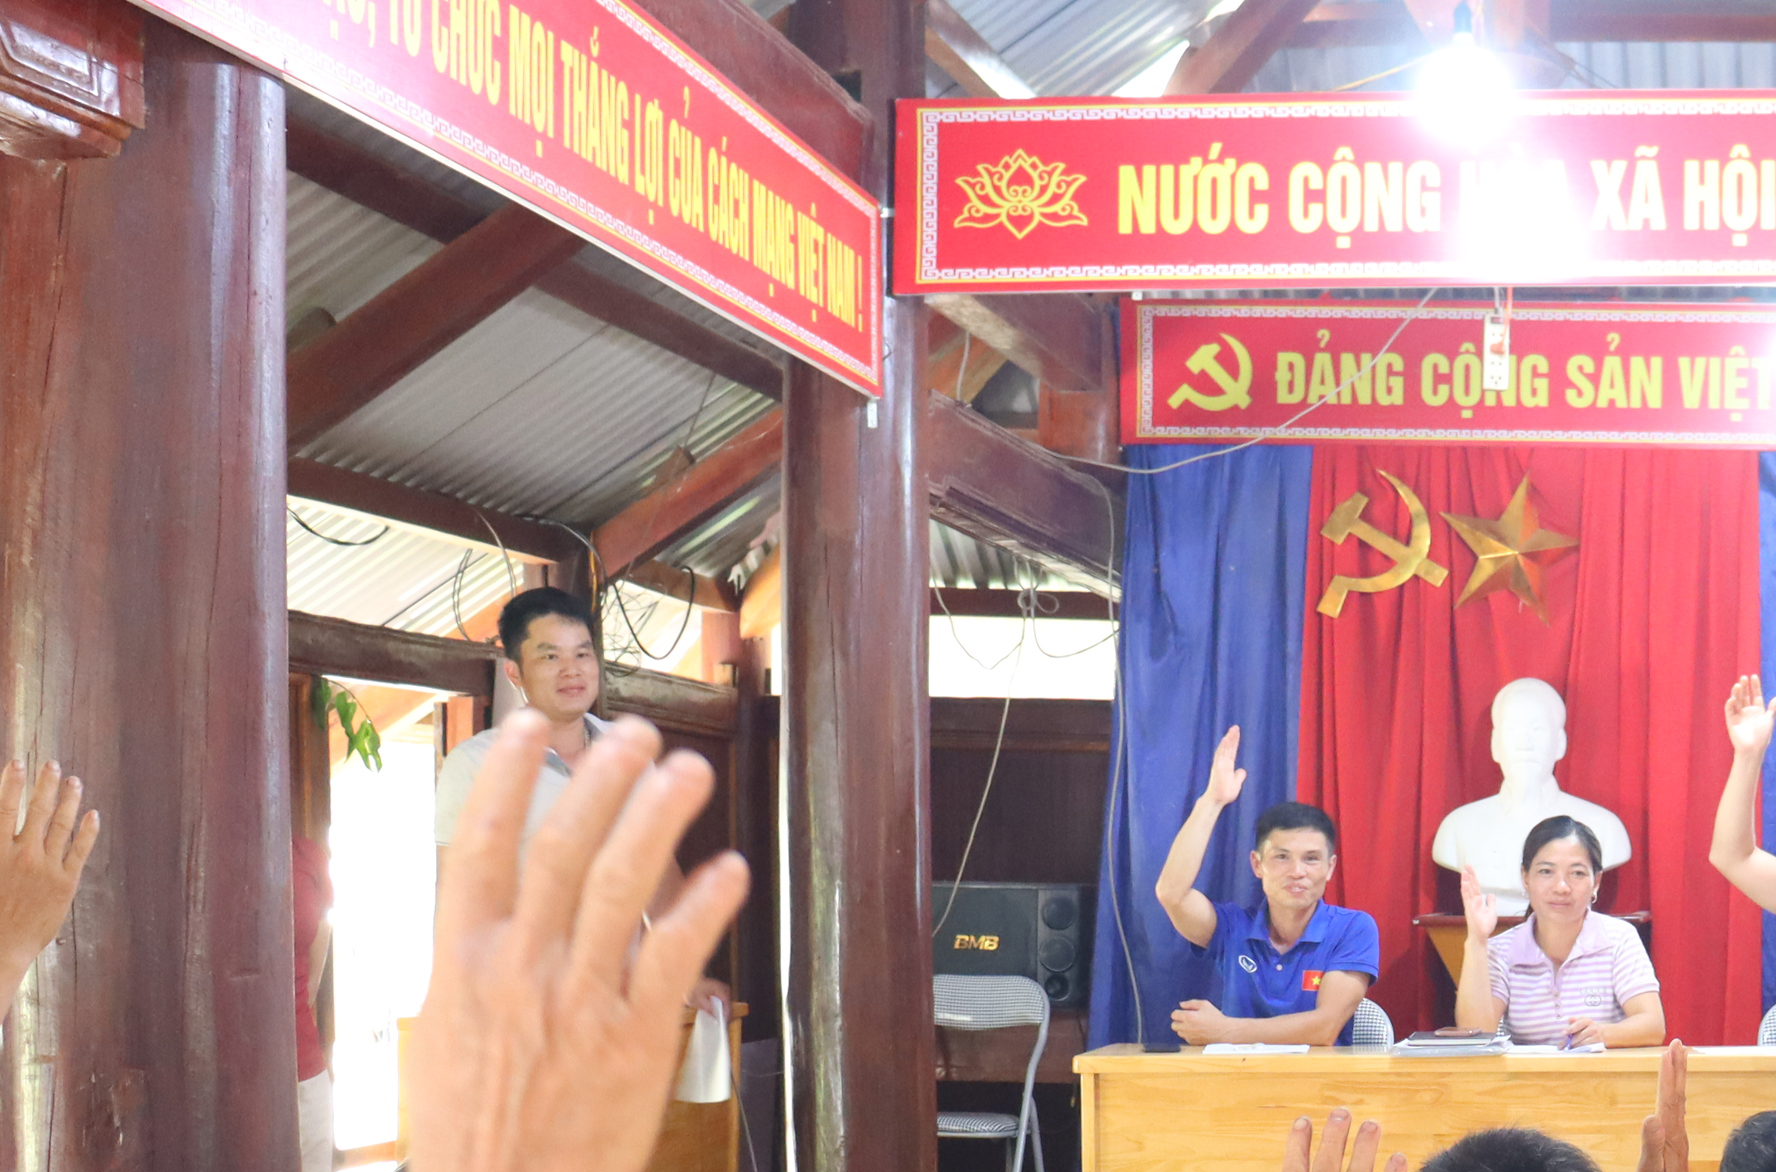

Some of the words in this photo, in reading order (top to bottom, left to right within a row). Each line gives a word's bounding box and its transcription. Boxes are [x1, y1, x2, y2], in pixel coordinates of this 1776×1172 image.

[509, 4, 554, 158] MỌI
[561, 26, 629, 185] THẮNG
[634, 93, 663, 225] LỢI
[669, 86, 704, 232] CỦA
[708, 136, 749, 261] CÁCH
[753, 179, 795, 297] MẠNG
[798, 203, 825, 323] VIỆT
[828, 233, 855, 328] NAM
[1118, 142, 1269, 235] NƯỚC
[1288, 147, 1441, 249] CỘNG
[1590, 145, 1667, 232] XÃ
[1683, 144, 1776, 247] HỘI
[1275, 331, 1404, 406] ĐẢNG
[1566, 333, 1663, 409] SẢN
[1678, 346, 1774, 422] VIỆT
[953, 934, 1000, 951] BMB
